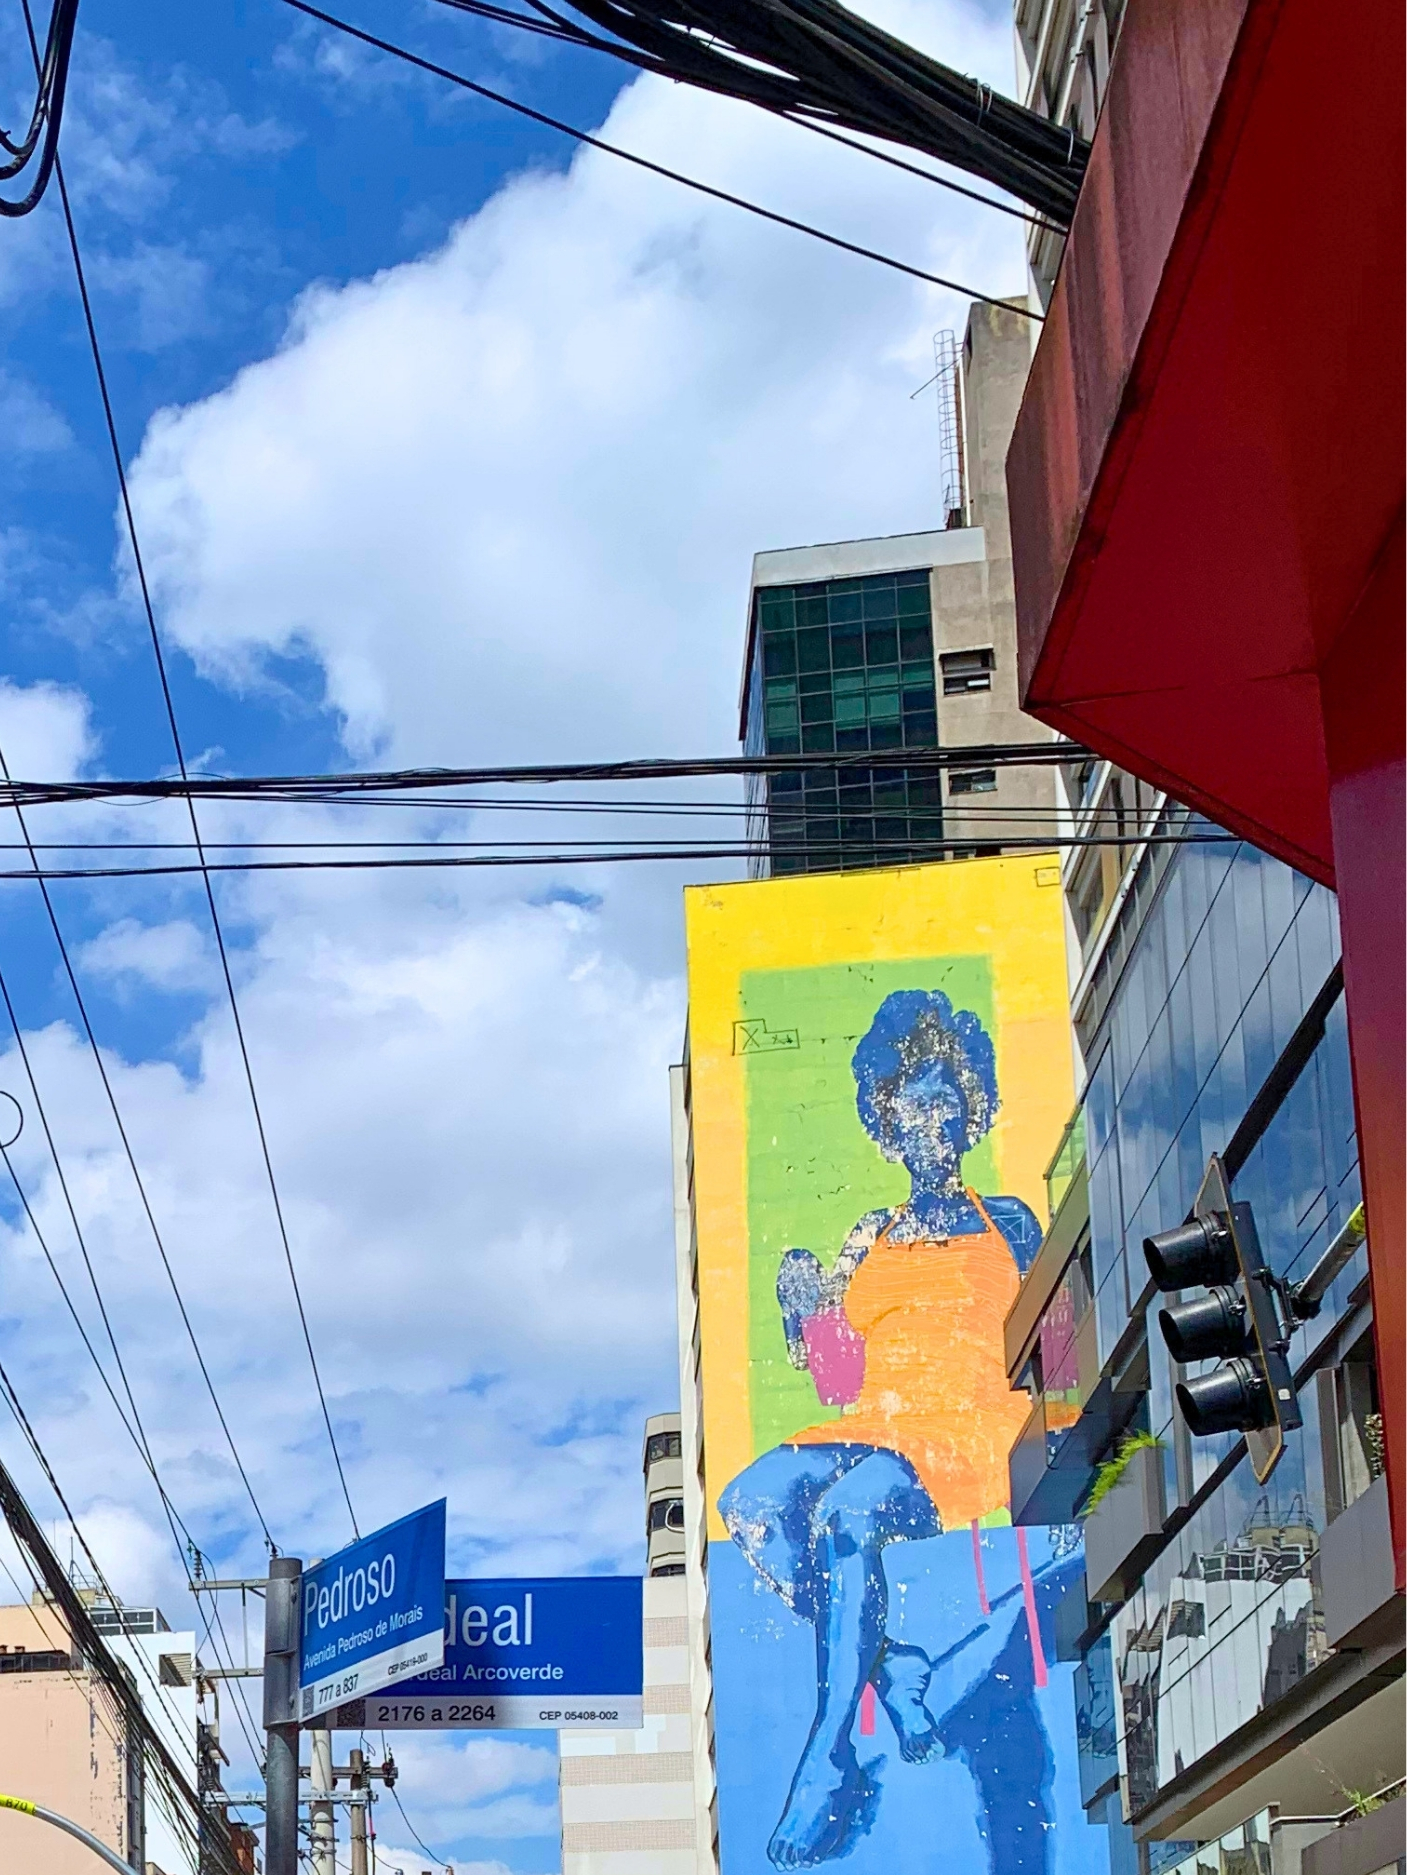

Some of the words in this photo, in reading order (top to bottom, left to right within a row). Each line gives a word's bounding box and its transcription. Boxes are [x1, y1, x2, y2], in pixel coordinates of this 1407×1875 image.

[304, 1553, 396, 1637] Pedroso
[444, 1592, 532, 1647] deal
[303, 1643, 337, 1671] Avenida
[337, 1628, 374, 1655] Pedroso
[375, 1620, 388, 1638] de
[389, 1604, 424, 1632] Morais
[387, 1663, 400, 1676] CEP
[462, 1663, 564, 1681] Arcoverde
[319, 1684, 334, 1705] 777
[335, 1682, 341, 1698] a
[342, 1673, 359, 1695] 837
[378, 1704, 426, 1722] 2176
[431, 1708, 443, 1721] a
[448, 1704, 496, 1721] 2264
[539, 1710, 562, 1720] CEP
[564, 1710, 619, 1721] 05408-002
[5, 1798, 28, 1811] 870
